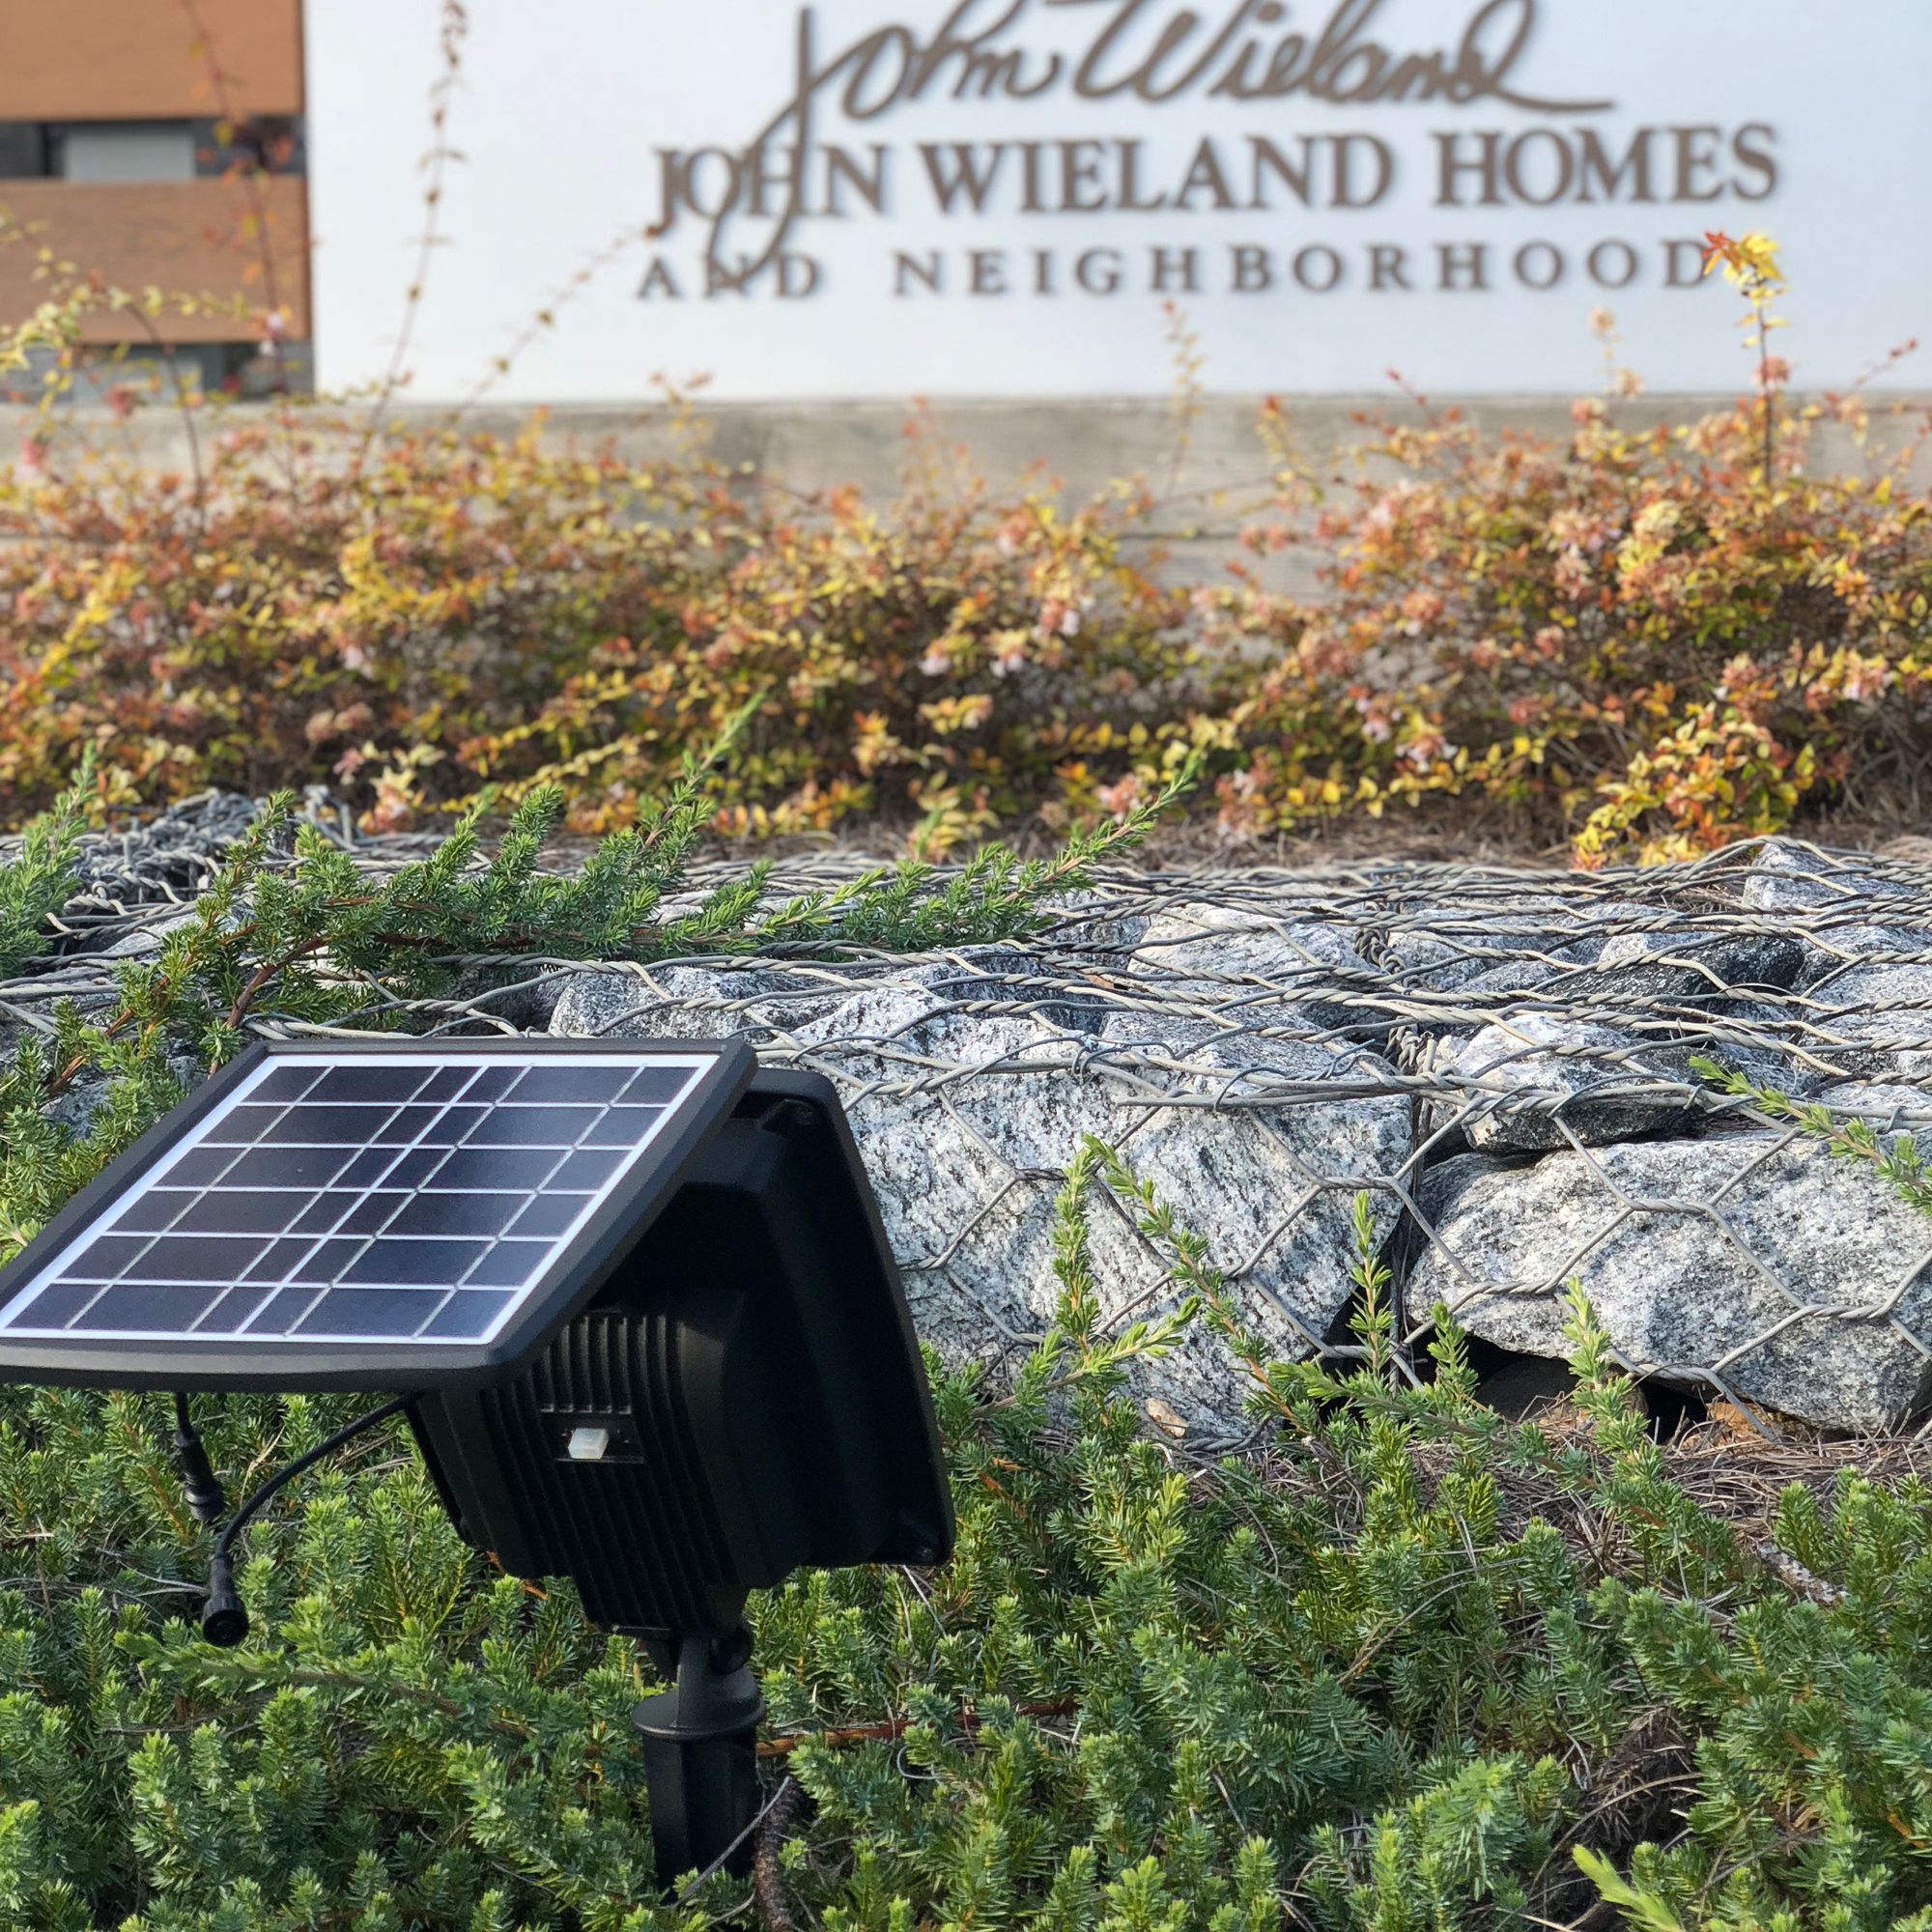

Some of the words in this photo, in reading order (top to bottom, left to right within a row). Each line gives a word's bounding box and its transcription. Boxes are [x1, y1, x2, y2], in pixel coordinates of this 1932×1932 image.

[649, 142, 888, 239] JOHN
[915, 132, 1394, 215] WIELAND
[1430, 123, 1779, 206] HOMES
[705, 0, 1063, 288] John
[1043, 0, 1615, 113] Wieland
[635, 247, 823, 299] AND
[891, 236, 1770, 298] NEIGHBORHOOD
